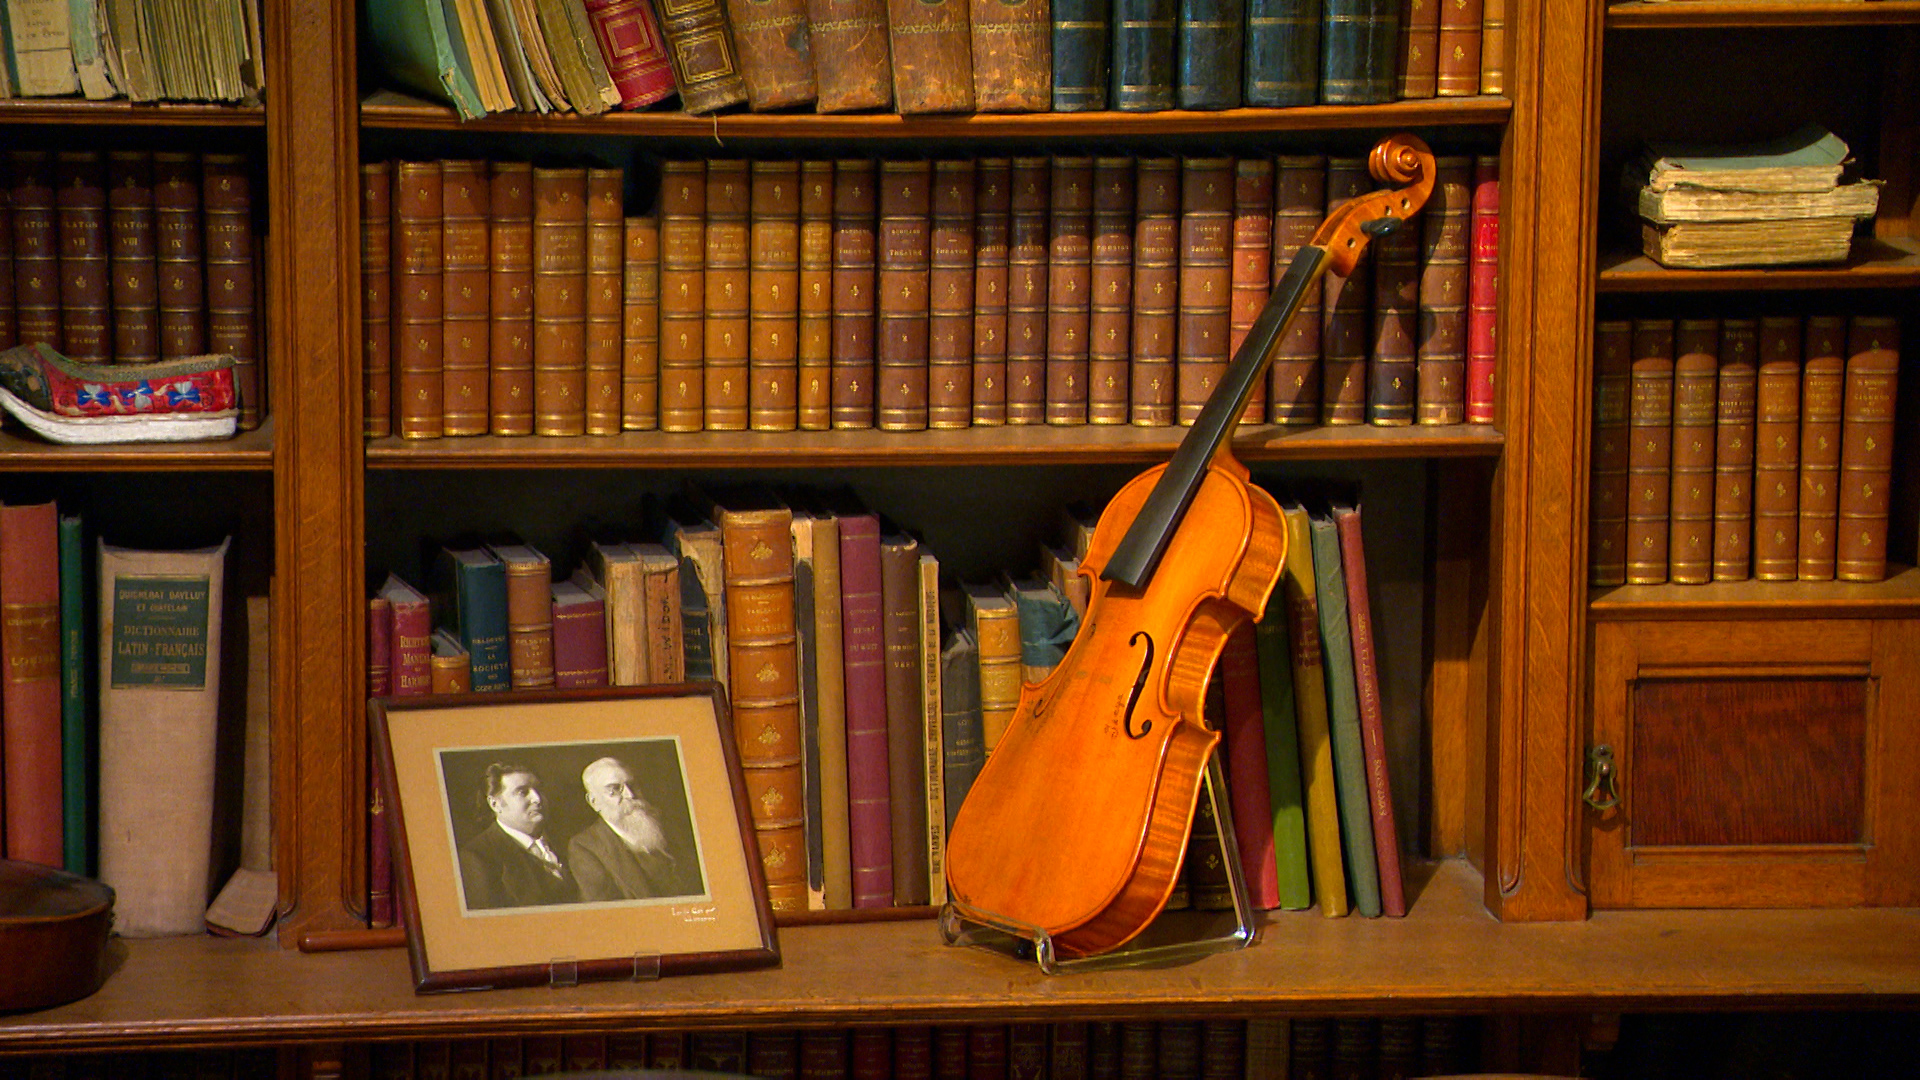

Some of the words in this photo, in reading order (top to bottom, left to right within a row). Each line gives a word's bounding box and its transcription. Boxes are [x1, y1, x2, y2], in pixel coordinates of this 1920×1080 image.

[122, 236, 138, 246] VIII
[171, 238, 182, 248] IX
[123, 625, 200, 637] DICTIONNAIRE
